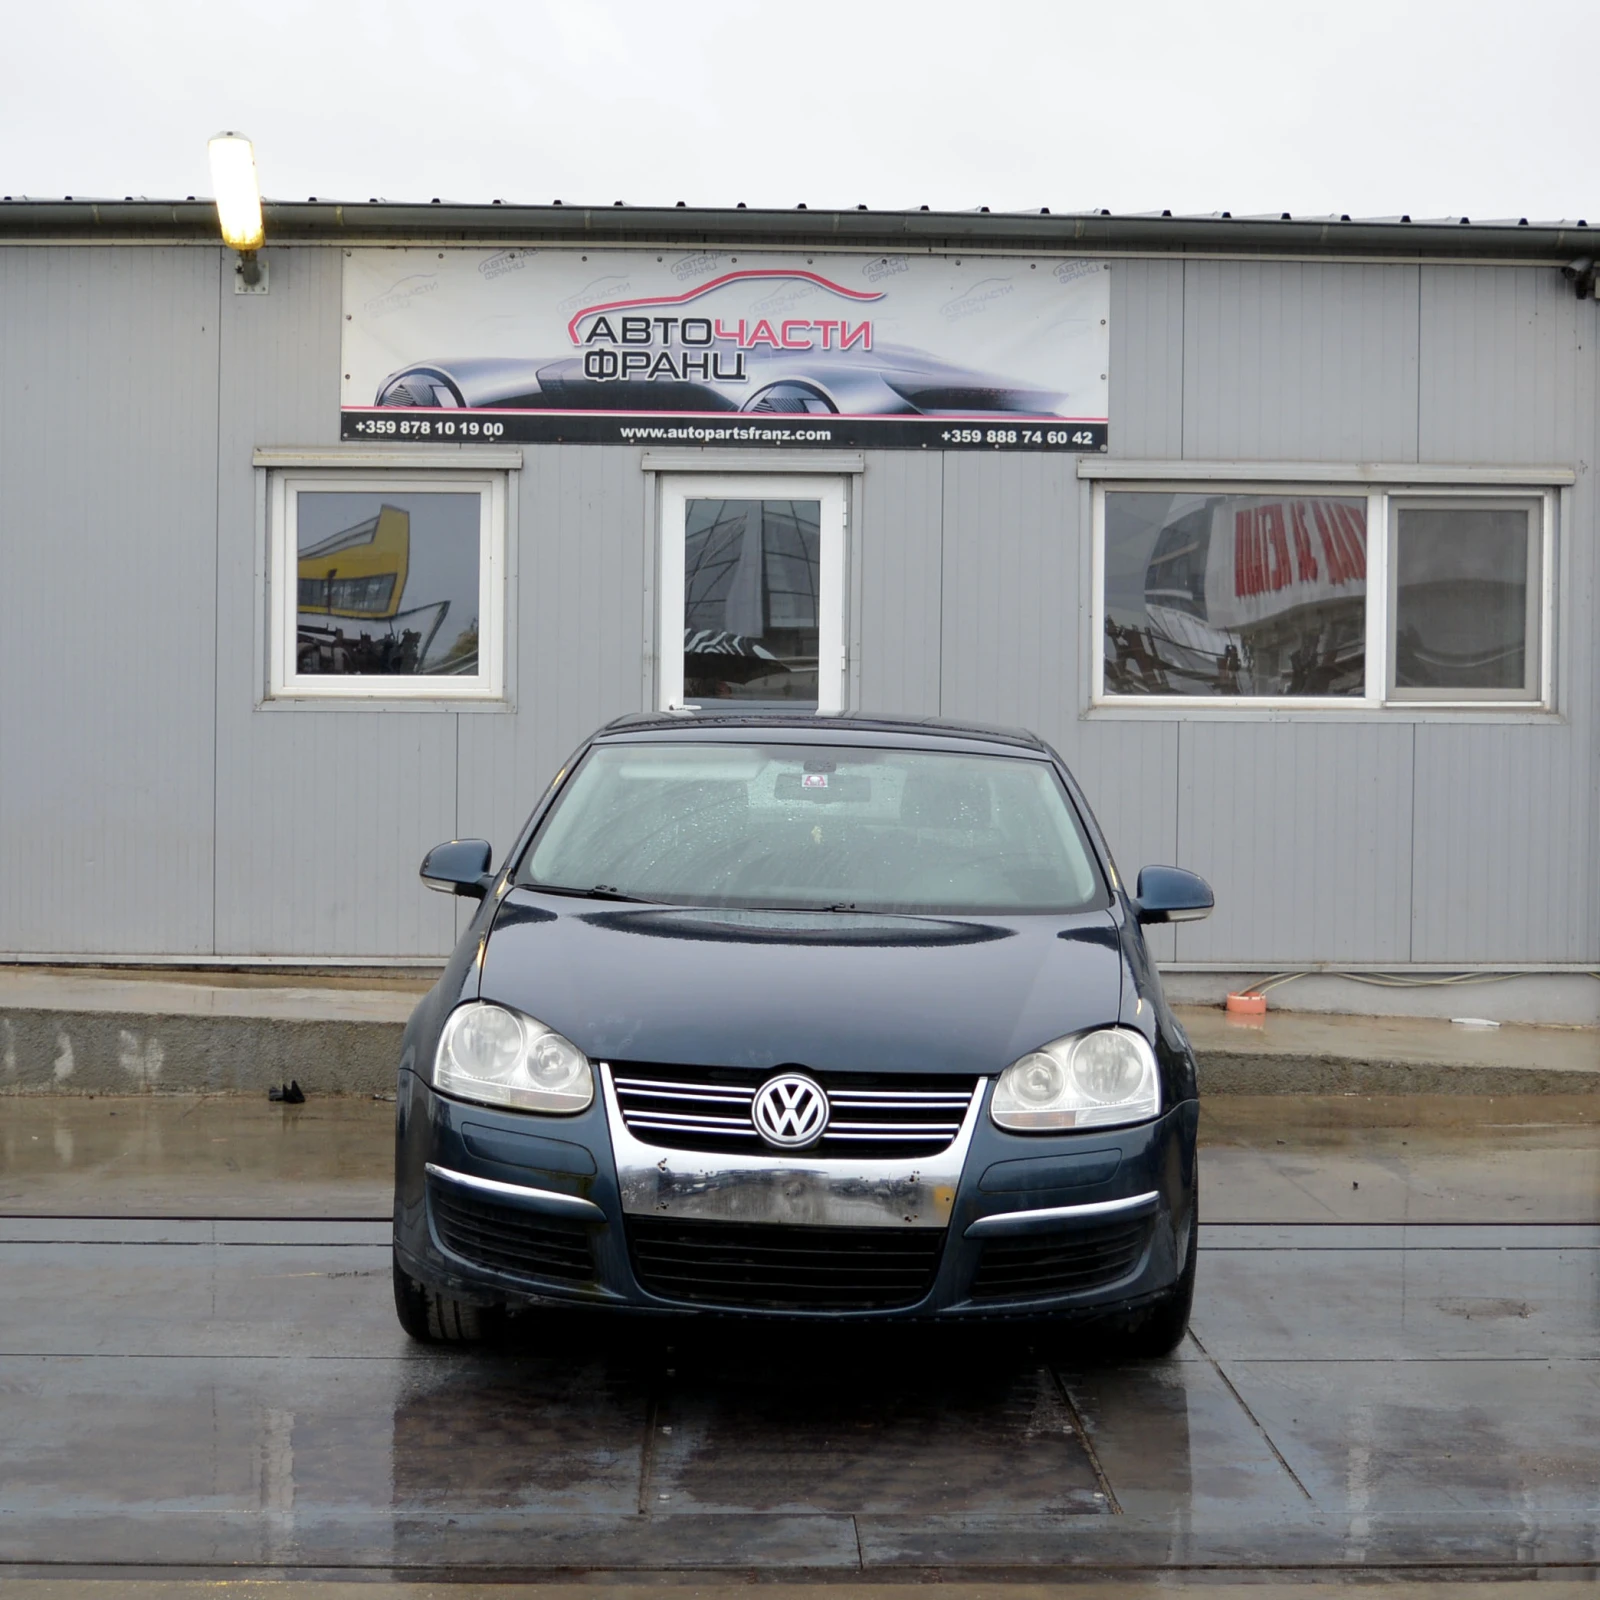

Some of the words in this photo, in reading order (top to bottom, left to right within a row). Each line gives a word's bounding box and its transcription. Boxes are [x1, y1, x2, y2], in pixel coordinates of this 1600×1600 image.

[584, 316, 872, 350] АВТОЧАСТИ
[583, 348, 748, 382] ФРАНЦ
[355, 420, 397, 435] +359
[399, 420, 431, 436] 878
[434, 421, 456, 436] 10
[459, 421, 480, 437] 19
[482, 422, 504, 437] 00
[619, 426, 832, 443] www.autopartsfranz.com
[941, 429, 982, 445] +359
[986, 429, 1018, 445] 888
[1021, 430, 1043, 445] 74
[1046, 430, 1068, 446] 60
[1071, 431, 1093, 446] 42
